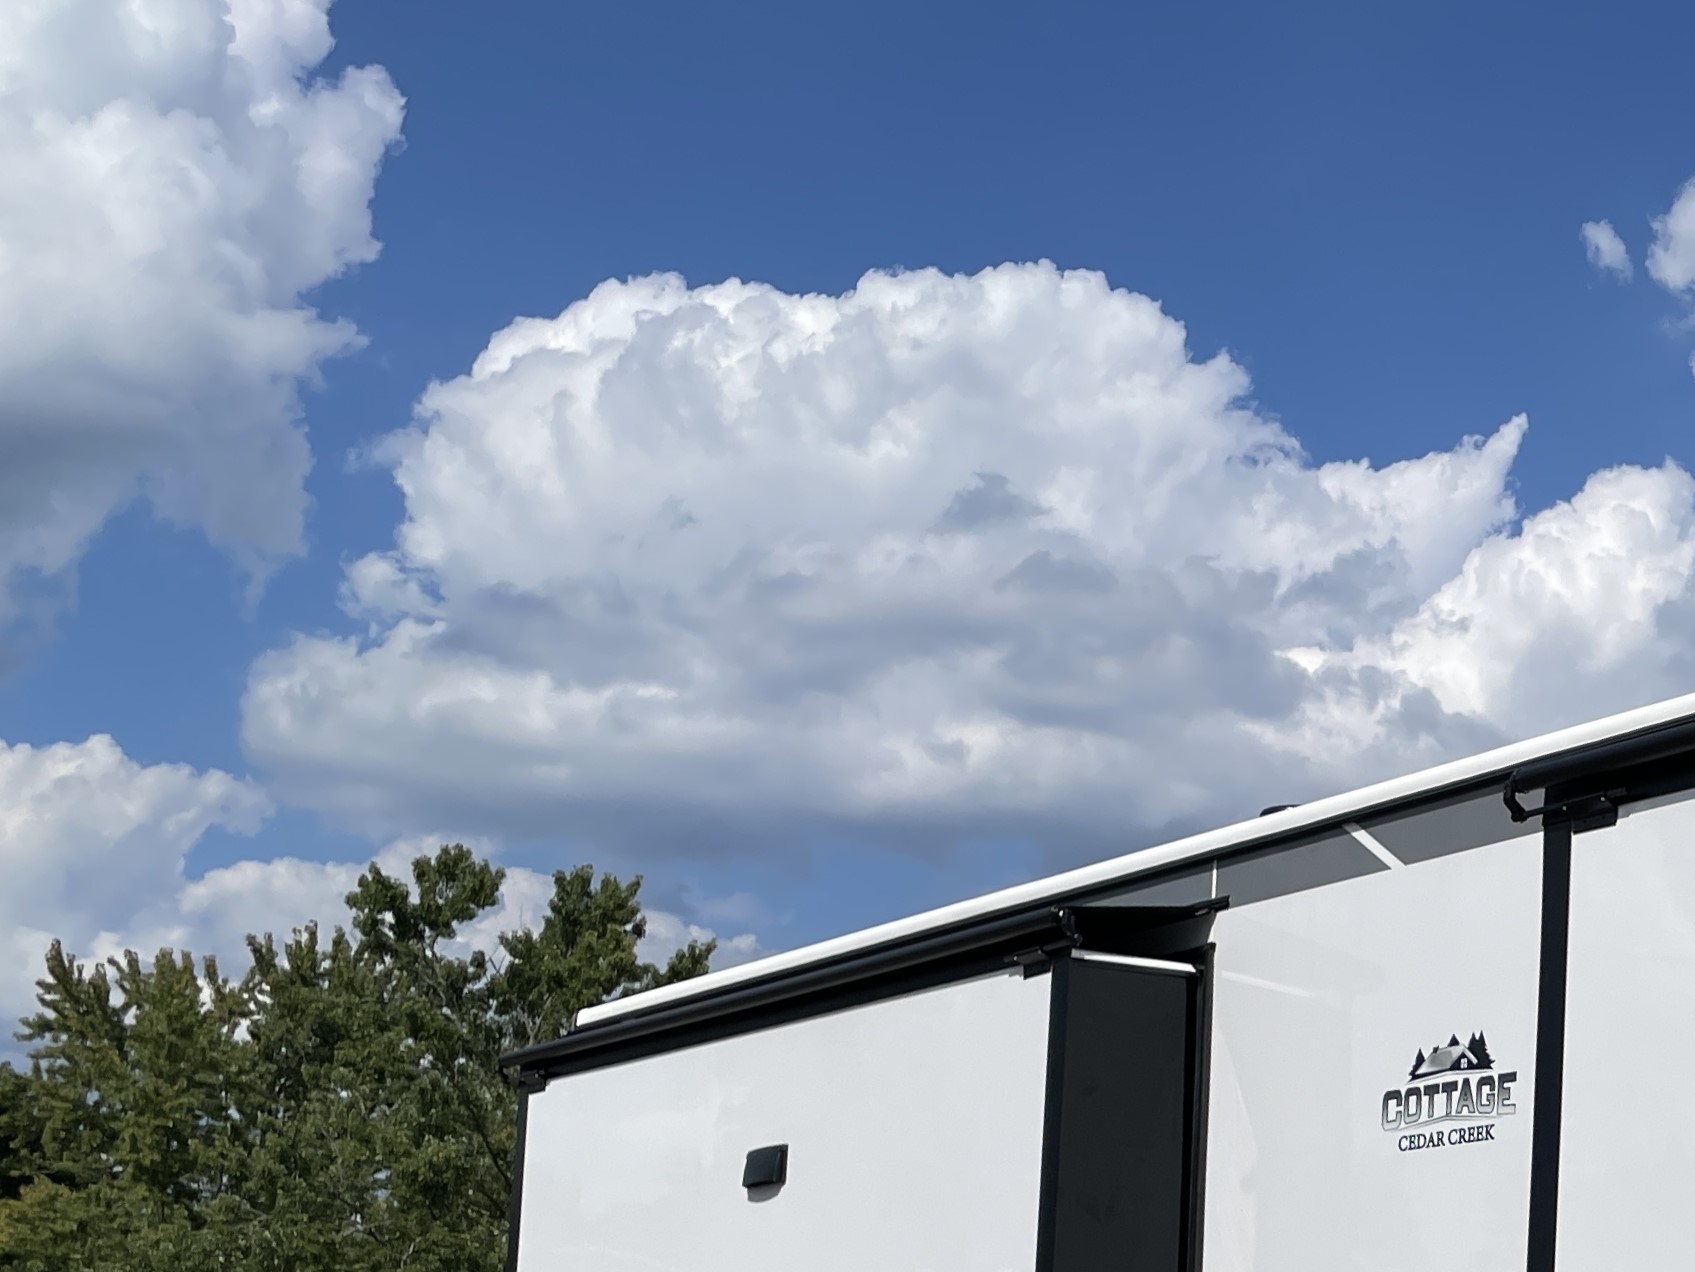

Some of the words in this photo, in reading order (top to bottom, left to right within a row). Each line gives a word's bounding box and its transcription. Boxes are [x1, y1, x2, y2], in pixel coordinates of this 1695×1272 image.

[1382, 1072, 1517, 1131] COTTAGE
[1399, 1131, 1445, 1151] CEDAR
[1448, 1124, 1495, 1145] CREEK
